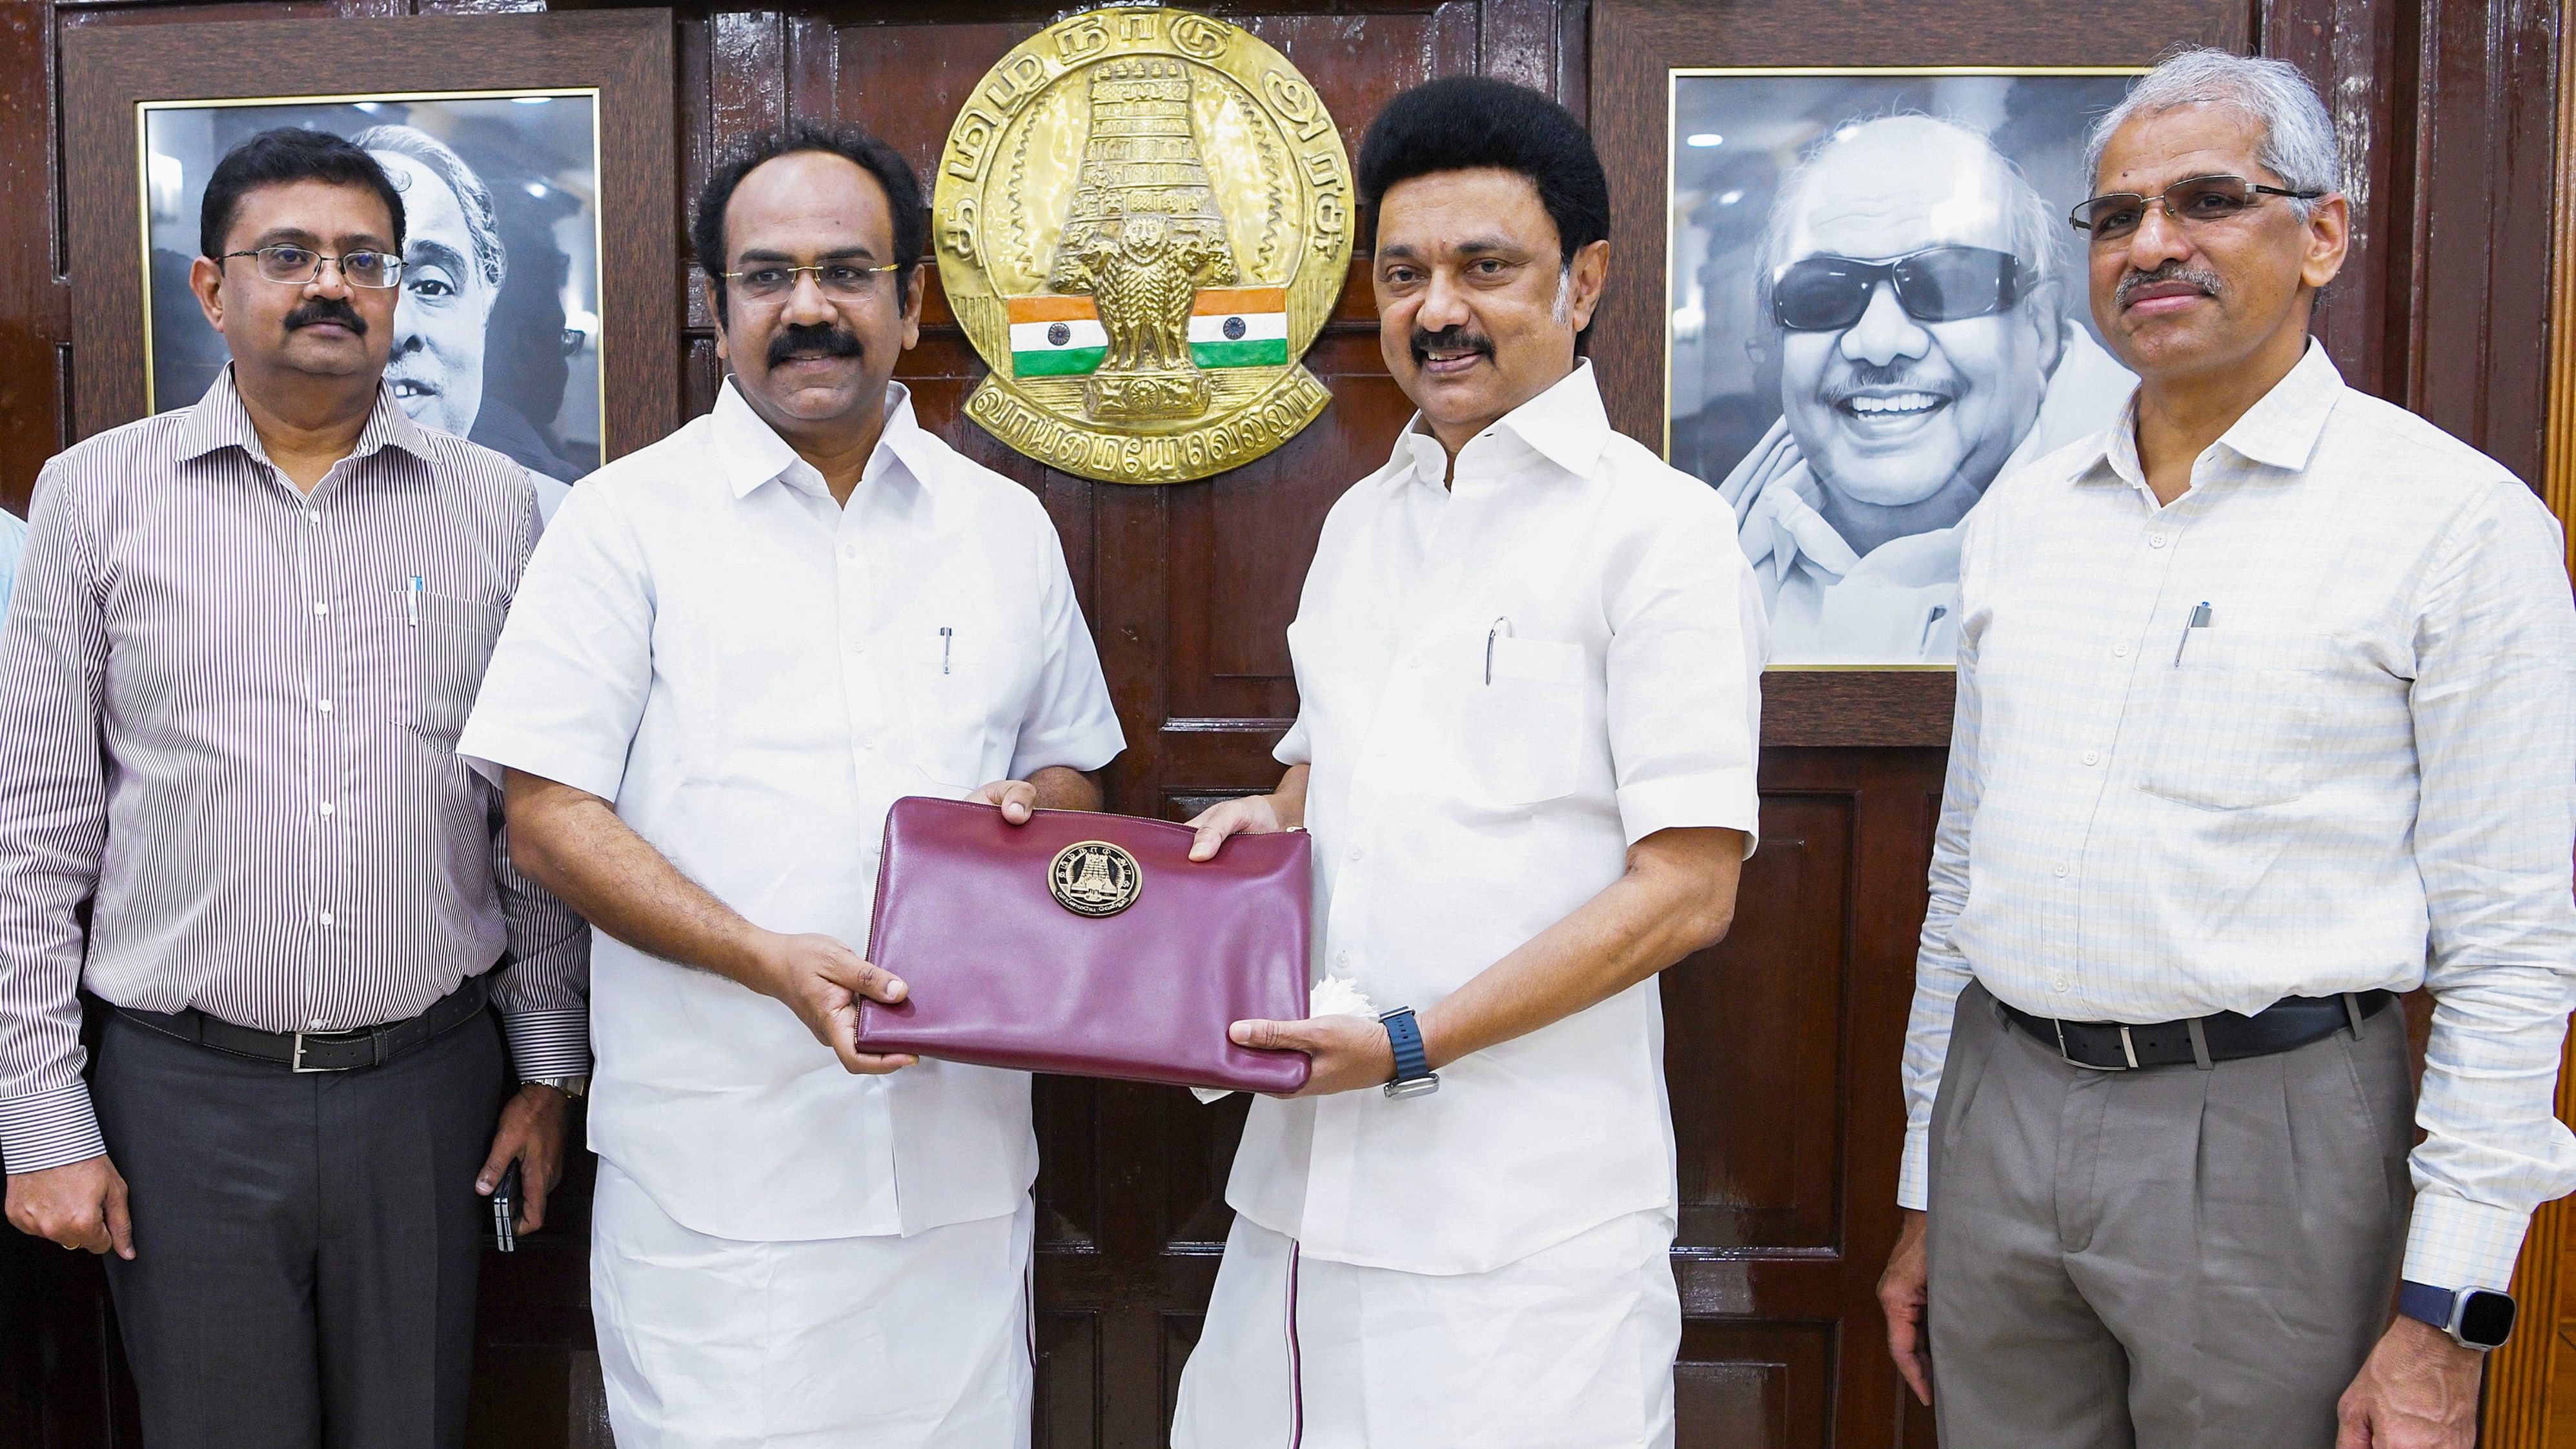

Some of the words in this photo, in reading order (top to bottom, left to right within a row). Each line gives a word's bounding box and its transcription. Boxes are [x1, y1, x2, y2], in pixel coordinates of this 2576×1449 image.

[1263, 69, 1347, 258] அரசு
[973, 386, 1179, 474] வாய்மையே
[1185, 374, 1323, 466] வெல்லும்
